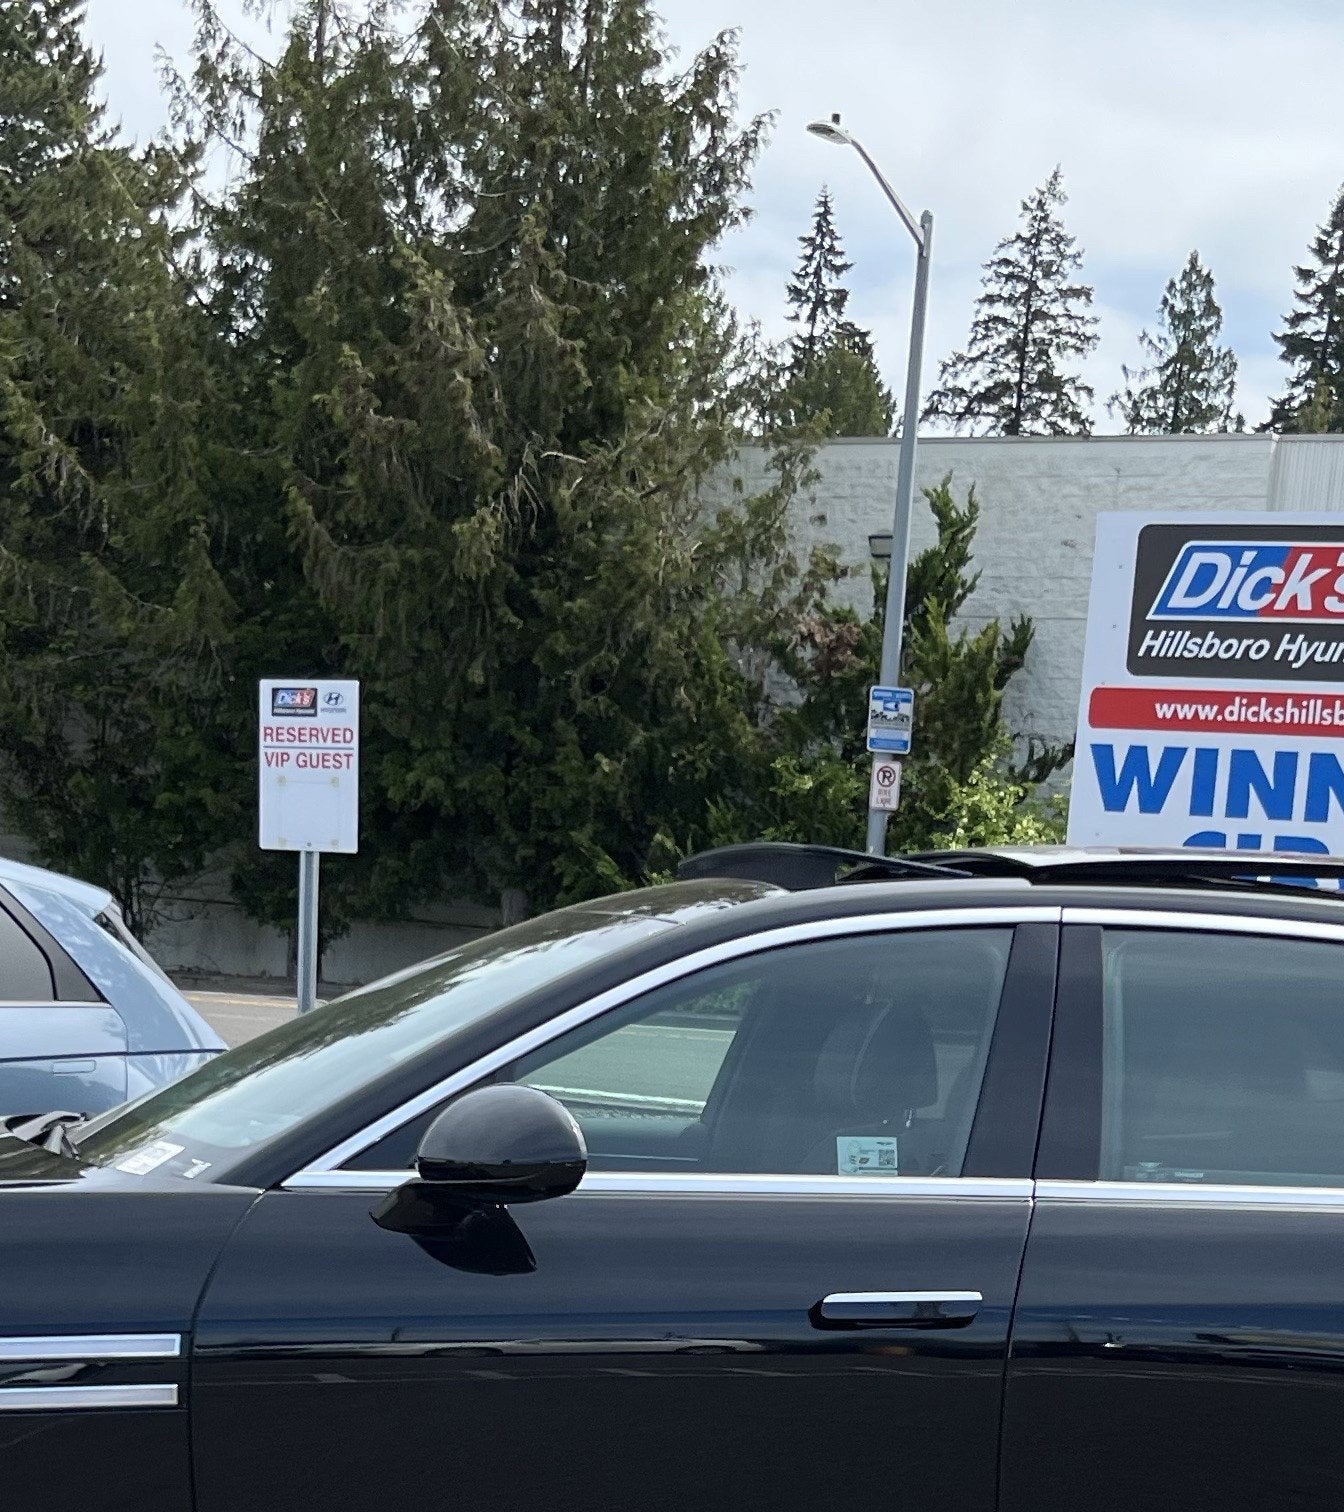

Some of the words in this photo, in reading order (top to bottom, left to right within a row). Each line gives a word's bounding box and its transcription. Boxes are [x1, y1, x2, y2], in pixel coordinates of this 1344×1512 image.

[1137, 629, 1271, 661] Hillsboro
[263, 725, 354, 744] RESERVED
[264, 751, 290, 768] VIP
[296, 751, 354, 770] GUEST
